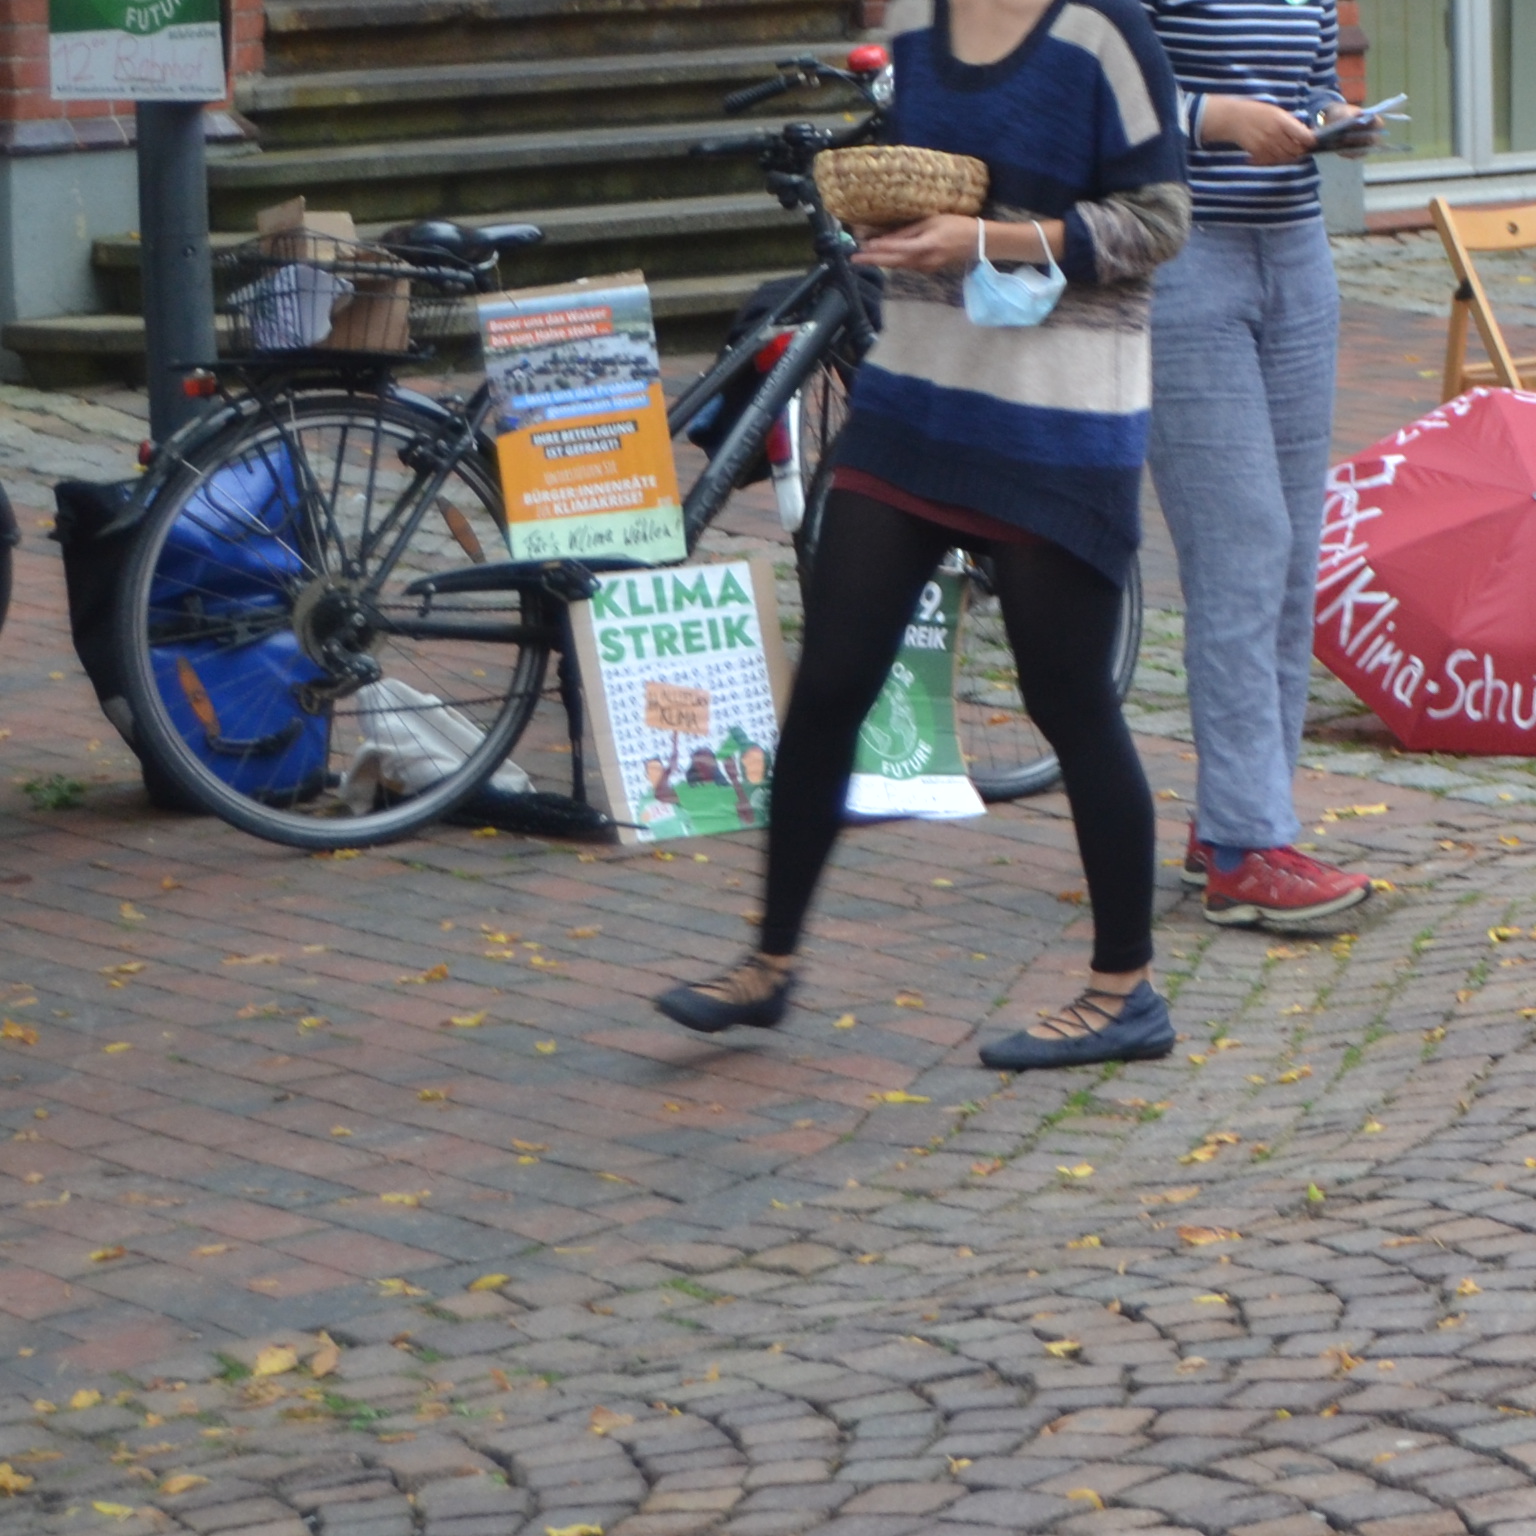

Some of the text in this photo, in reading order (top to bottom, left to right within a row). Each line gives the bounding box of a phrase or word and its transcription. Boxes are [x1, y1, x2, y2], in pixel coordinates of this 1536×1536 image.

[592, 567, 752, 620] KLIMA
[600, 614, 756, 664] STREIK
[881, 738, 934, 778] FUTURE
